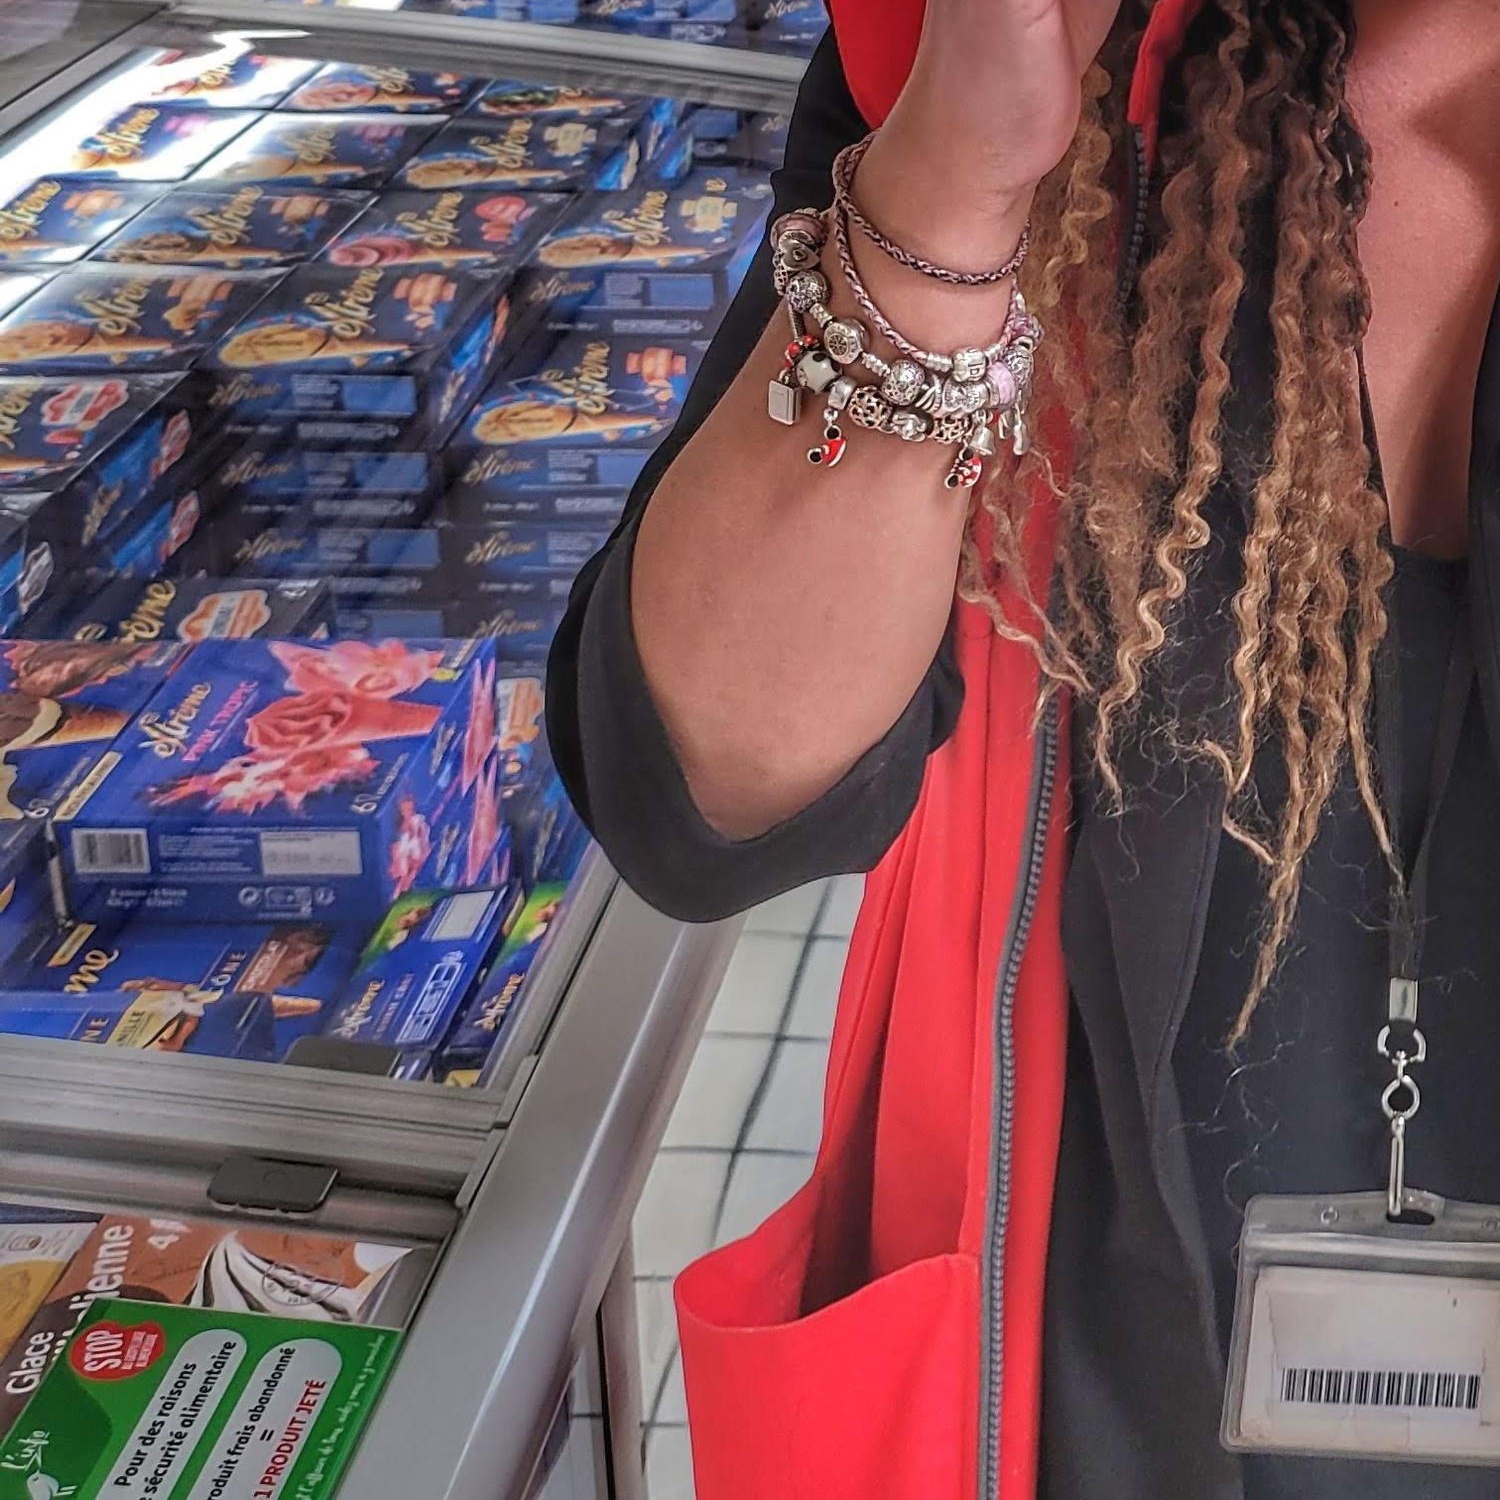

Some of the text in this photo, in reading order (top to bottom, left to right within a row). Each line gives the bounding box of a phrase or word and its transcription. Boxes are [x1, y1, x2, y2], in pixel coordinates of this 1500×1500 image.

[5, 1330, 55, 1395] Glace
[83, 1330, 124, 1372] STOP
[114, 1361, 198, 1487] Pour des raisons
[142, 1338, 237, 1496] sécurité alimentaire
[203, 1346, 297, 1500] roduit frais abandonné
[260, 1415, 306, 1487] PRODUIT
[295, 1376, 326, 1414] JETÉ
